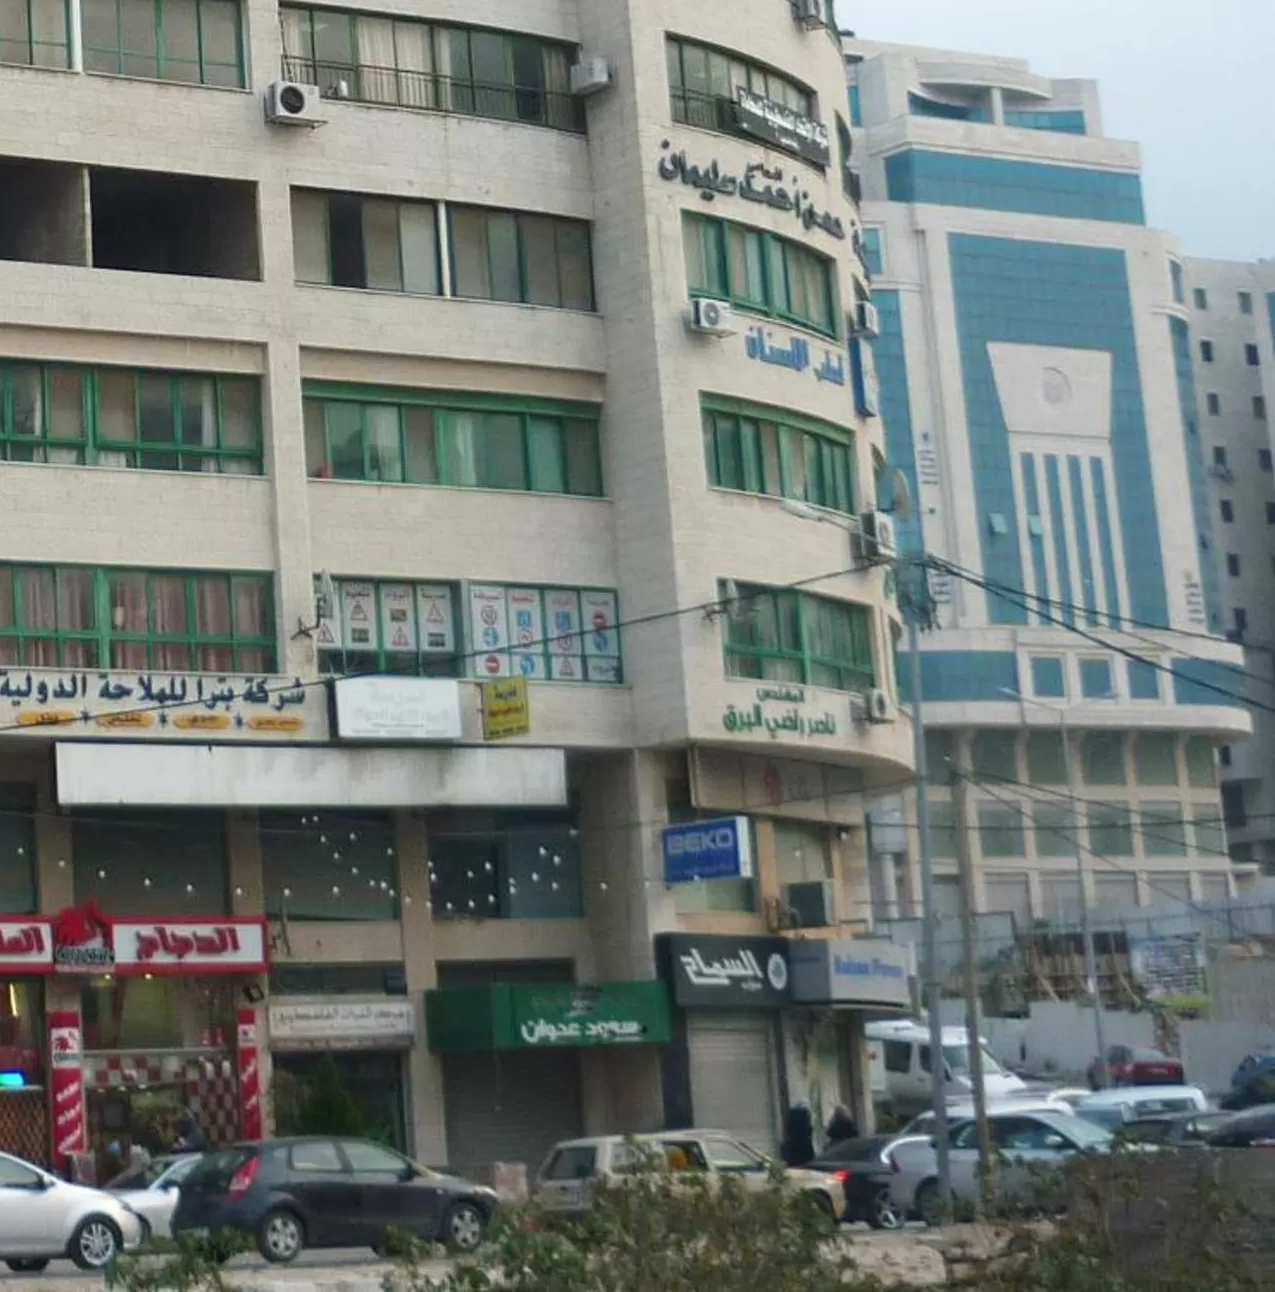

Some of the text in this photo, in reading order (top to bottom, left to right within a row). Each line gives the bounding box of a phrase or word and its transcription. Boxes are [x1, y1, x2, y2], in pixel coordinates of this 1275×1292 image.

[666, 826, 734, 856] BEKO
[136, 926, 240, 960] الدجاج
[680, 948, 764, 985] السماح
